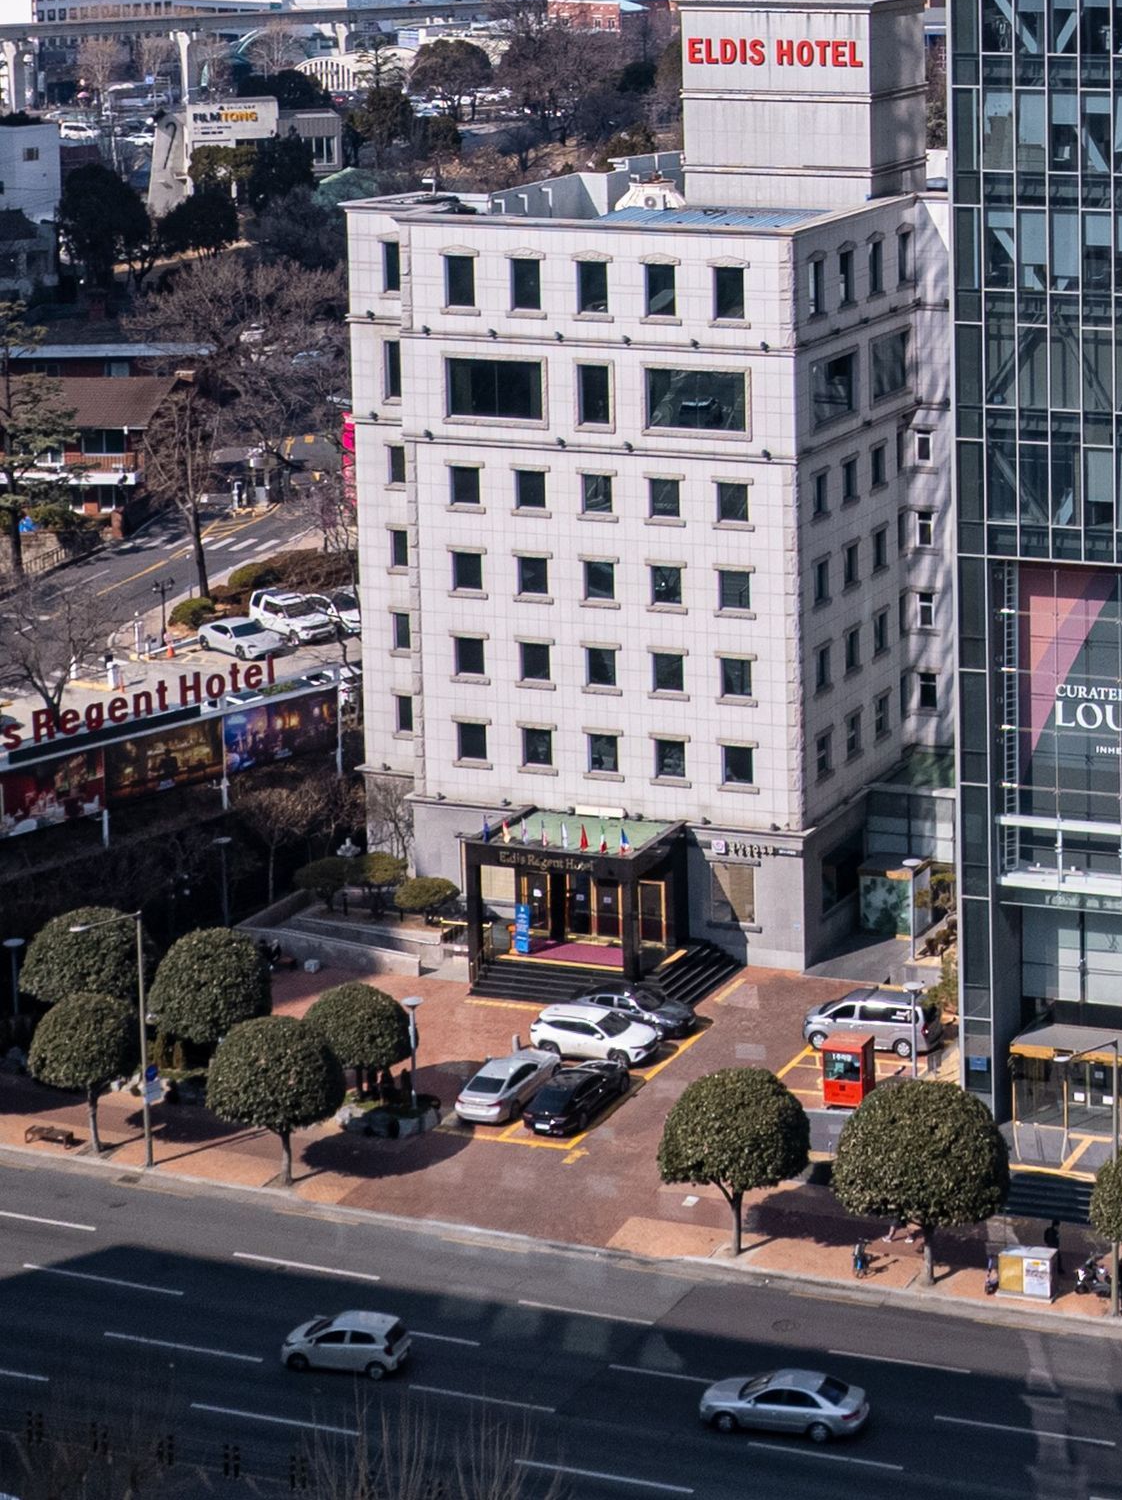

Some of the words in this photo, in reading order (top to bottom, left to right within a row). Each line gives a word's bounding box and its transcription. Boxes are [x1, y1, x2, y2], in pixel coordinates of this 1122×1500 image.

[687, 37, 766, 66] ELDIS
[775, 39, 864, 68] HOTEL
[32, 680, 169, 744] Regent
[179, 653, 276, 707] Hotel
[527, 853, 565, 872] Regent
